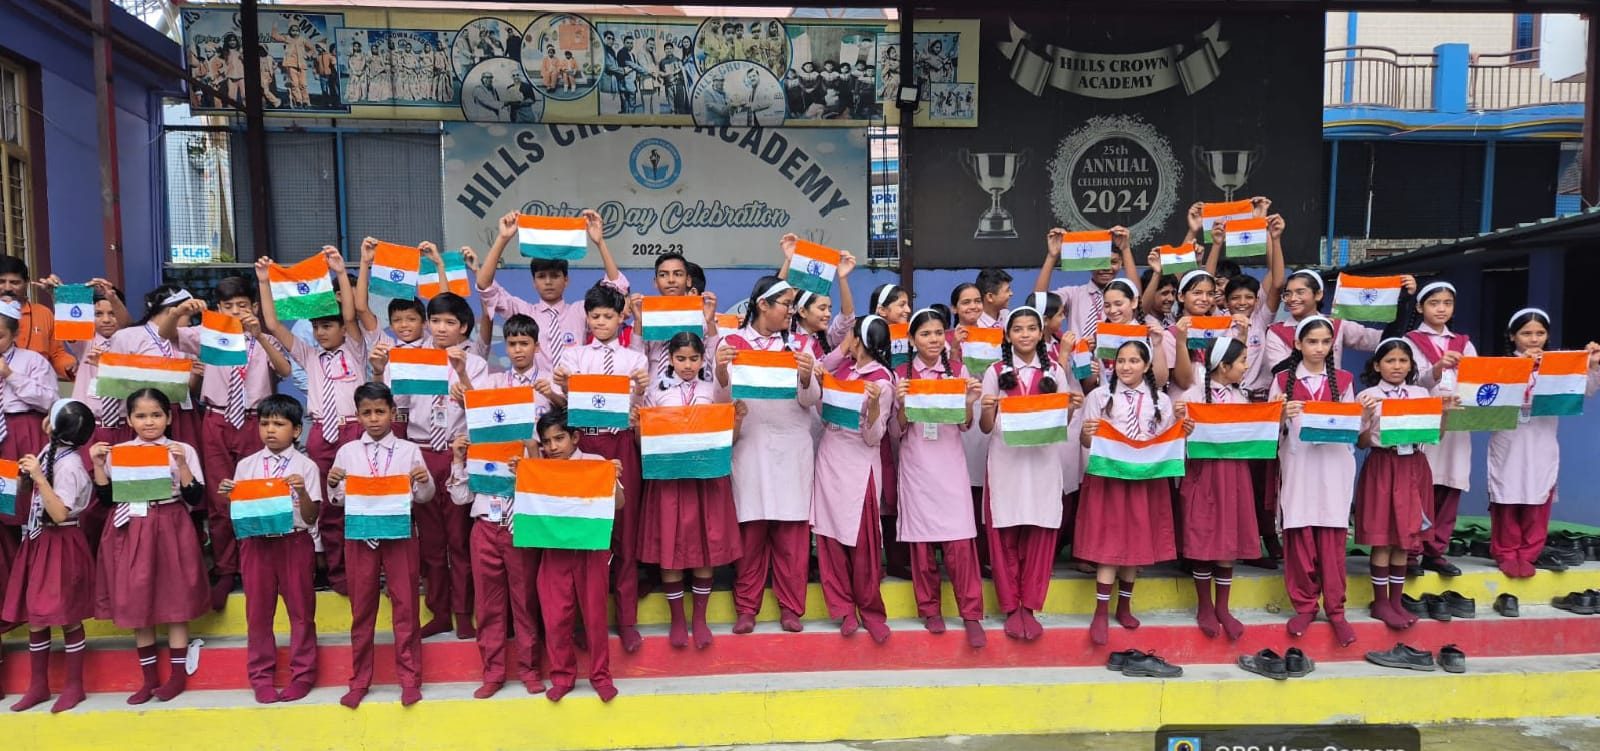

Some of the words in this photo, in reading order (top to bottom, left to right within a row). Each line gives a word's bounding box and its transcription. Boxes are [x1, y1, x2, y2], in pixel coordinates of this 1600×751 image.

[1061, 56, 1105, 72] HILLS
[1109, 55, 1169, 72] CROWN
[1078, 74, 1155, 89] ACADEMY
[1103, 145, 1129, 155] 25th
[1082, 158, 1150, 173] ANNUAL
[457, 131, 545, 219] HILLS
[1077, 177, 1135, 187] CELEBRATION
[1136, 177, 1153, 186] DAY
[1082, 189, 1150, 213] 2024
[598, 200, 658, 239] Day
[660, 200, 790, 234] Celebration
[632, 243, 684, 256] 2022-23
